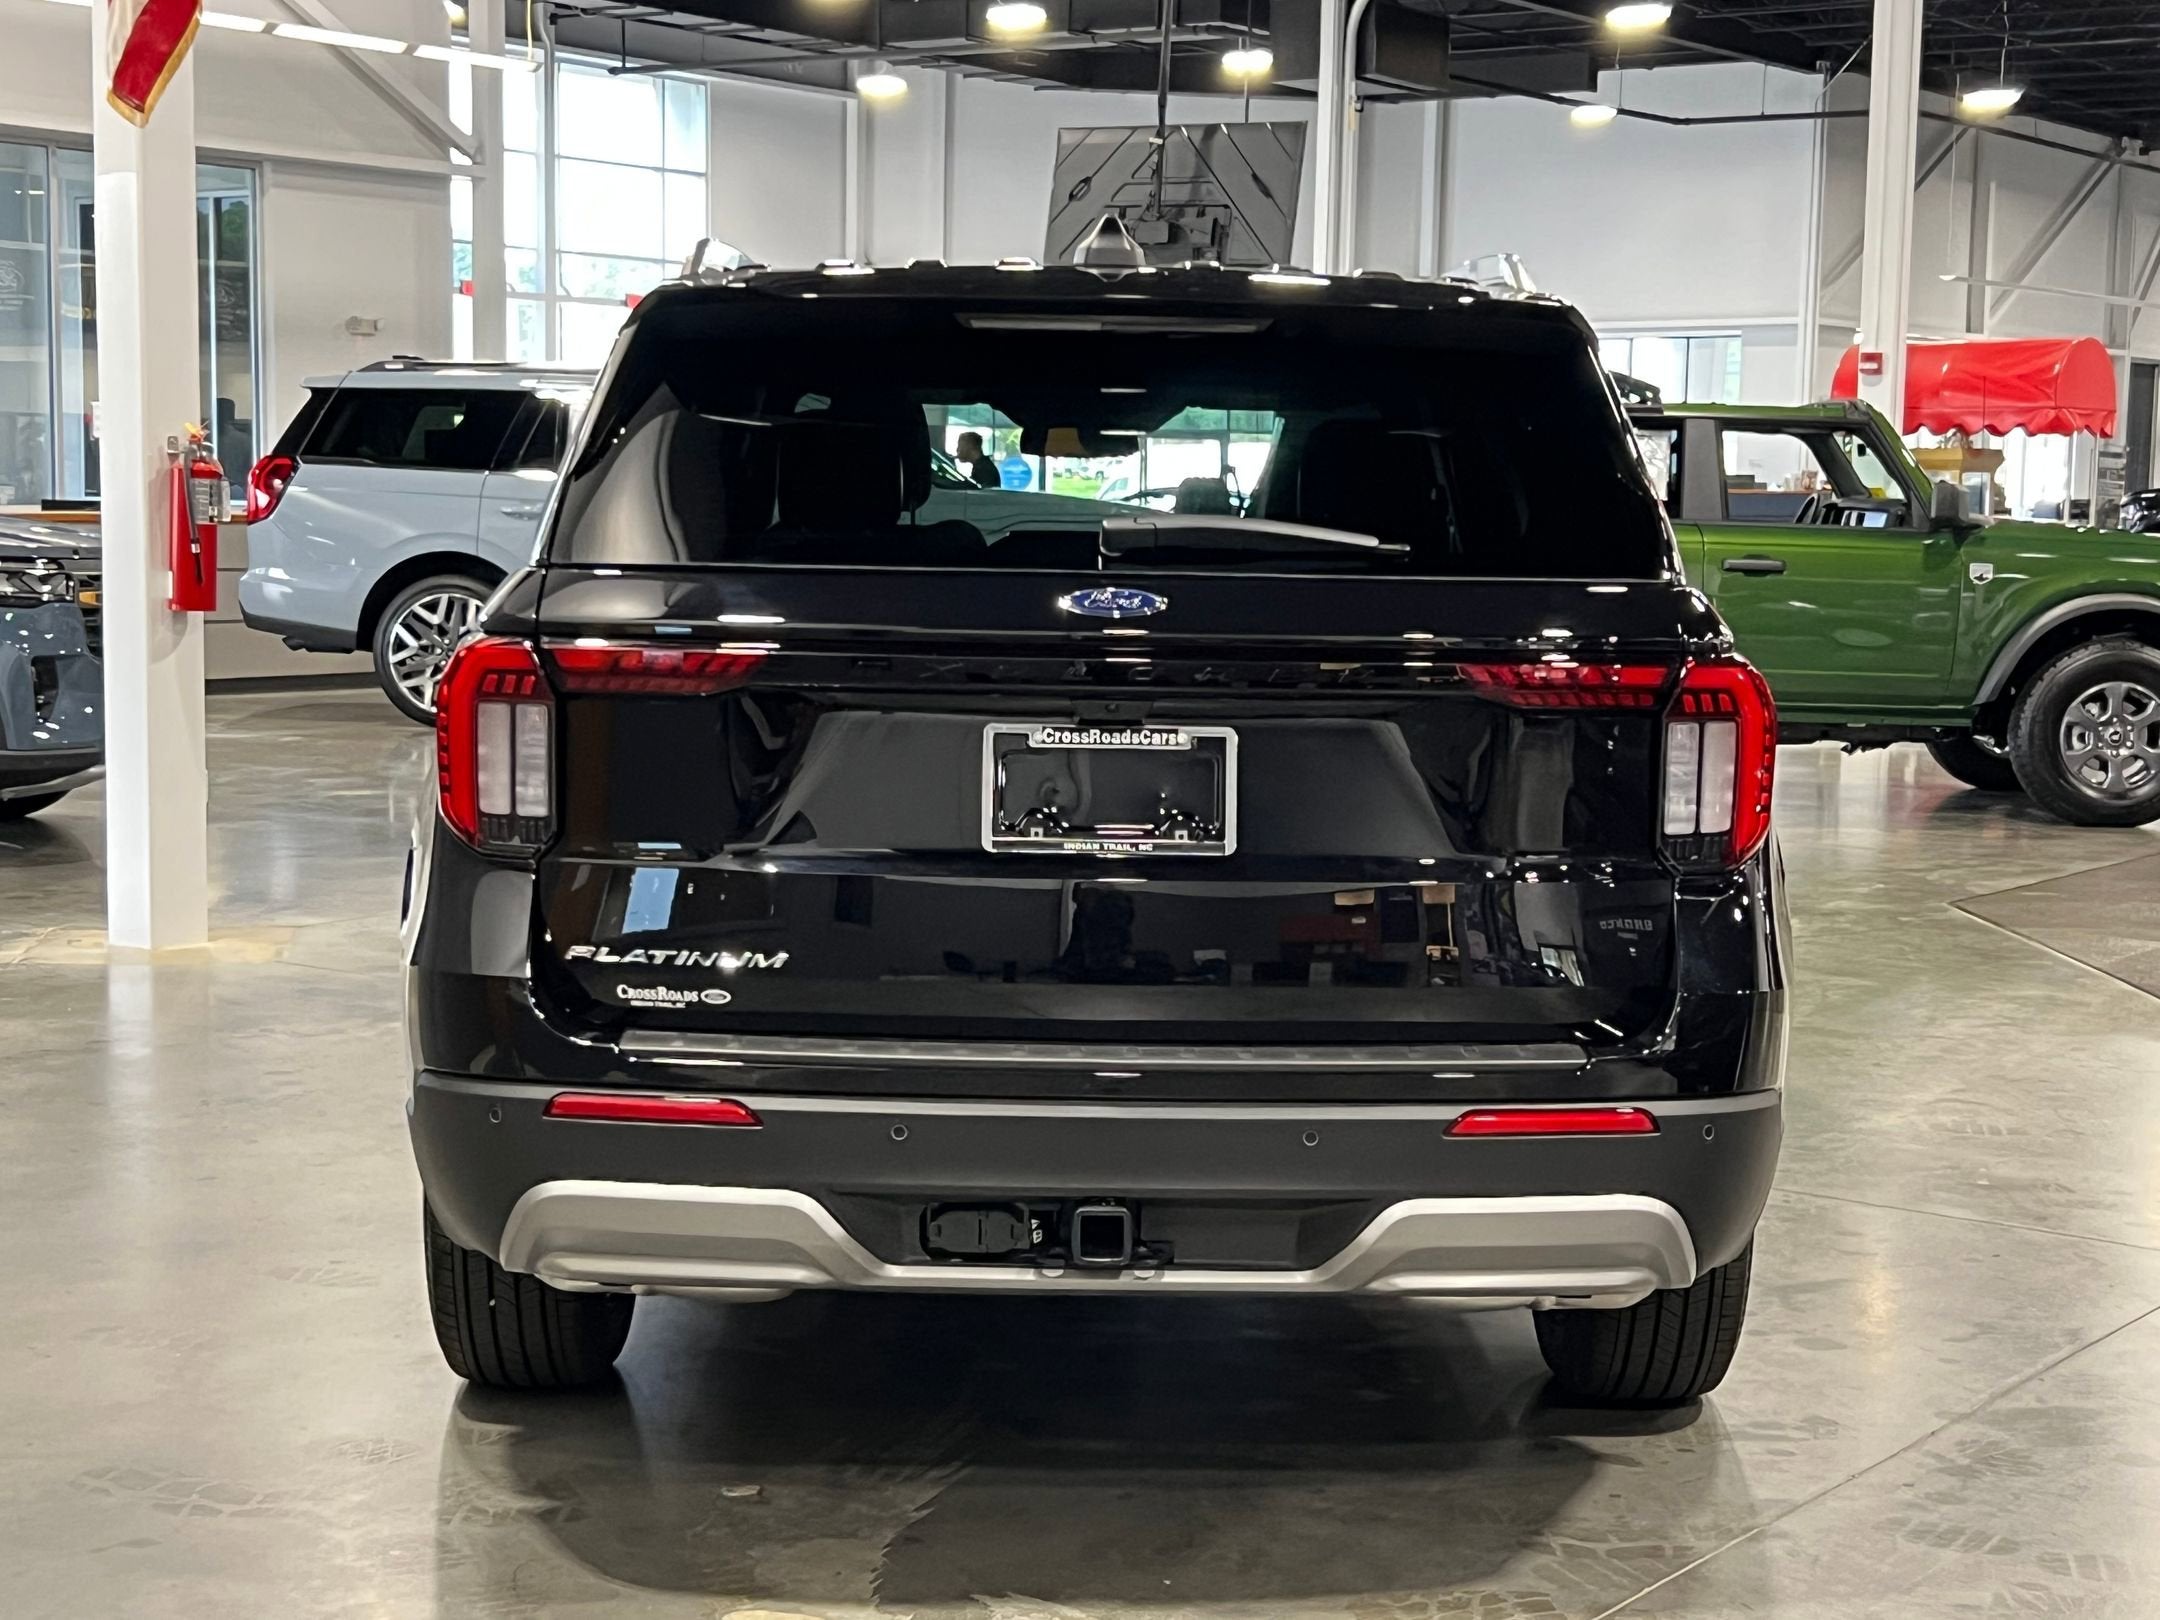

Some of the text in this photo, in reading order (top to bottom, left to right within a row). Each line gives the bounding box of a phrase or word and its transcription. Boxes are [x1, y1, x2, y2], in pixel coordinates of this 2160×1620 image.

[1084, 591, 1143, 609] Ford
[1042, 727, 1177, 745] CrossRoadsCars
[1063, 842, 1101, 851] INDIAN
[1138, 843, 1153, 852] NC
[563, 945, 790, 970] PLATINUM
